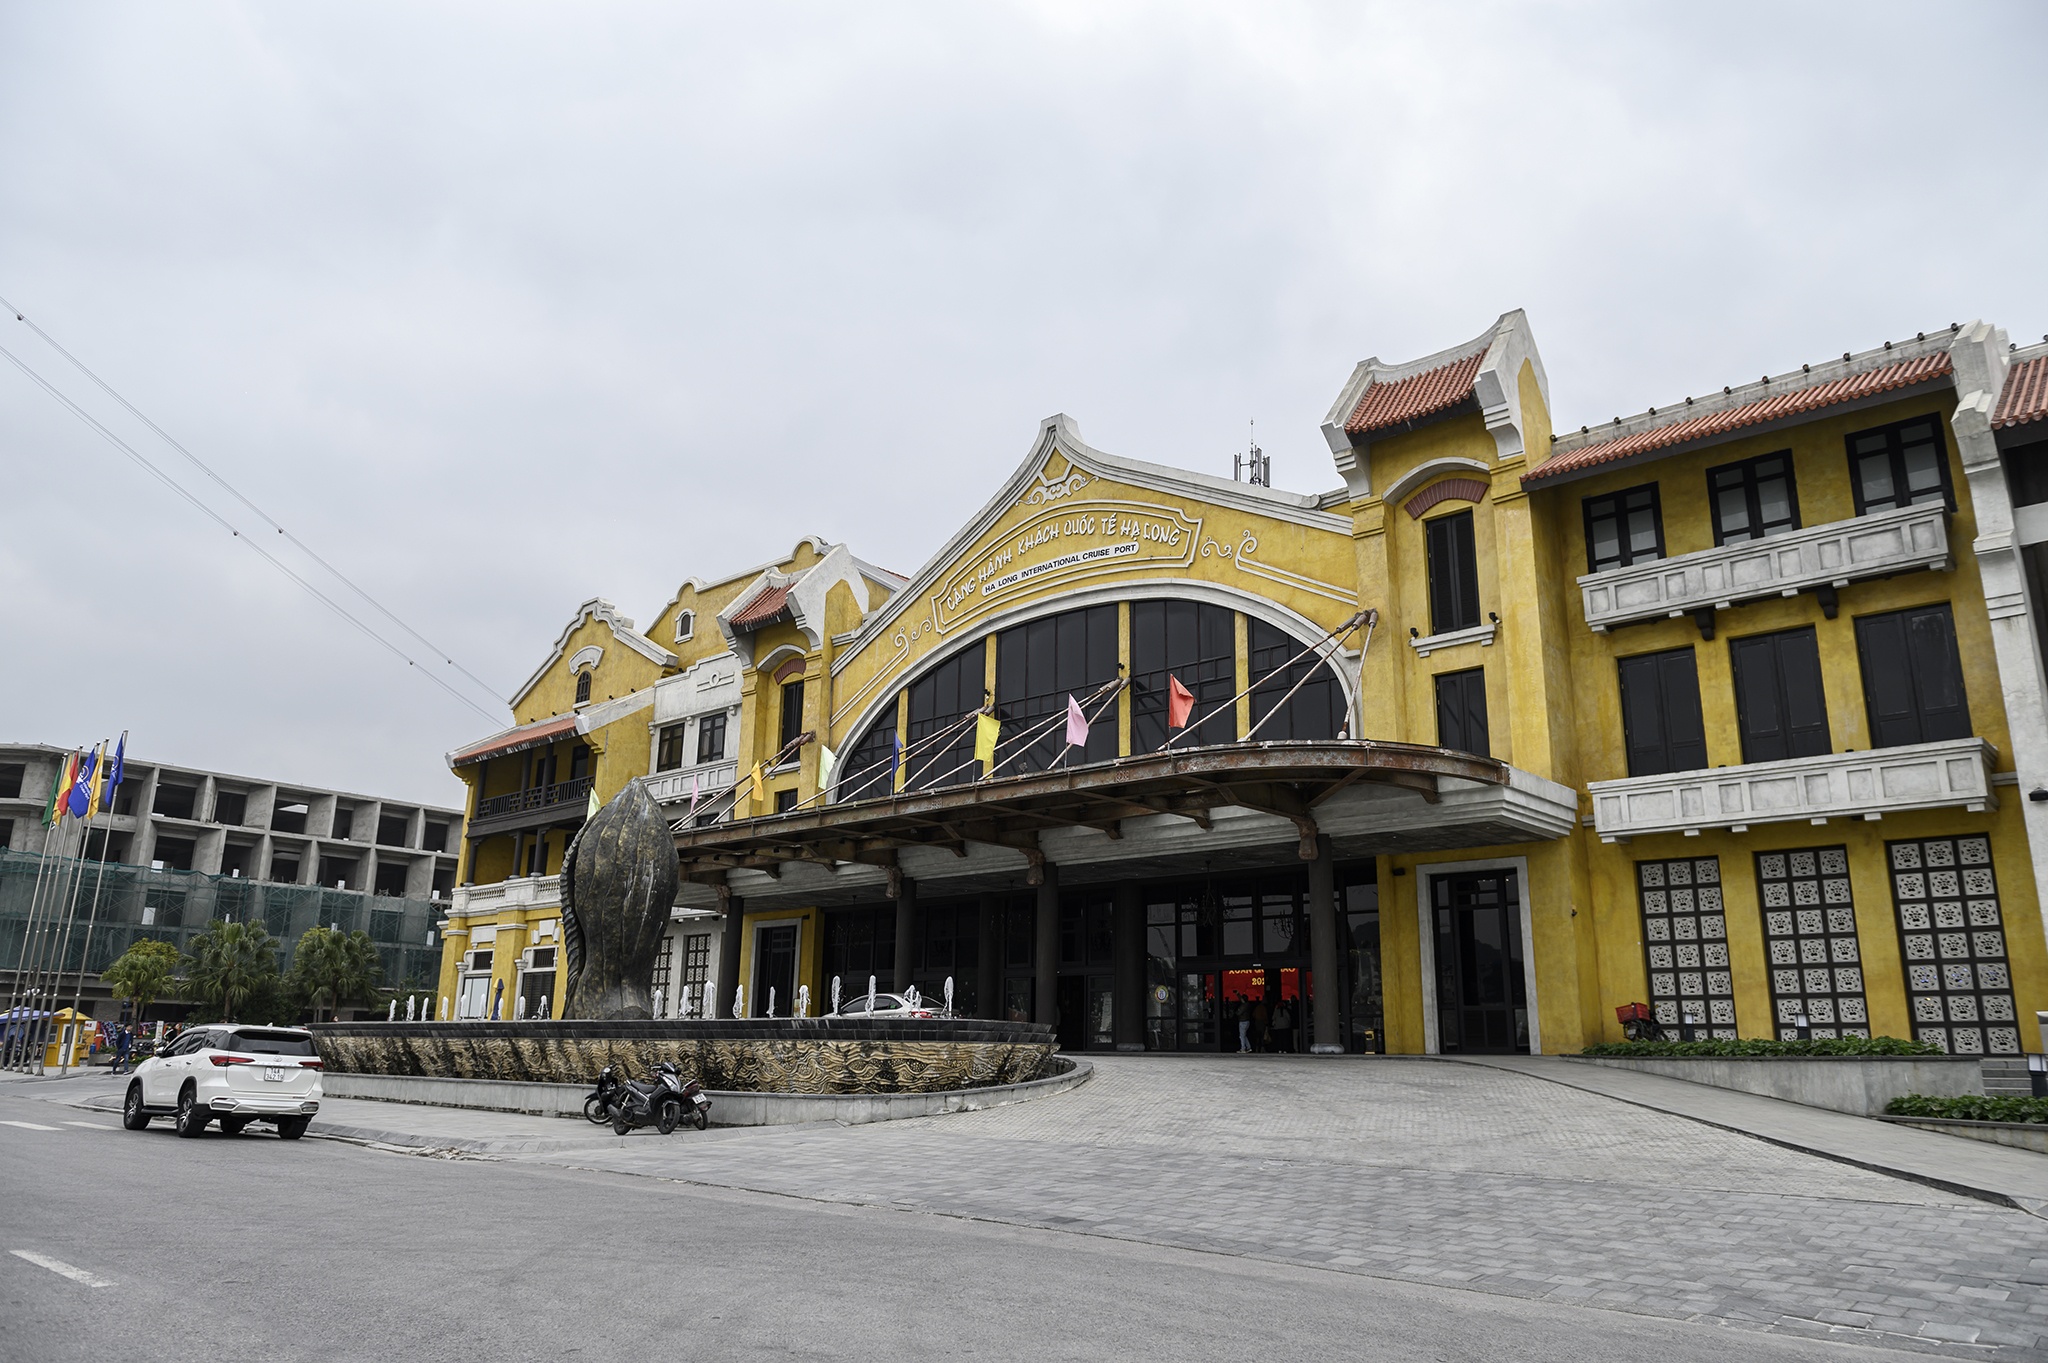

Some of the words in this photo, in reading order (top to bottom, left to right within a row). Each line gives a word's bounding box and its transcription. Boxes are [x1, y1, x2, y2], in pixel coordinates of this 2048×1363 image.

[1017, 522, 1060, 555] KHÁCH
[1063, 514, 1096, 536] QUỐC
[1101, 512, 1117, 536] TẾ
[1120, 519, 1140, 541] HẠ
[1143, 522, 1181, 546] LONG
[984, 584, 996, 594] HA
[998, 574, 1018, 587] LONG
[1021, 554, 1080, 578] INTERNATIONAL
[1082, 548, 1110, 560] CRUISE
[1114, 543, 1136, 554] PORT
